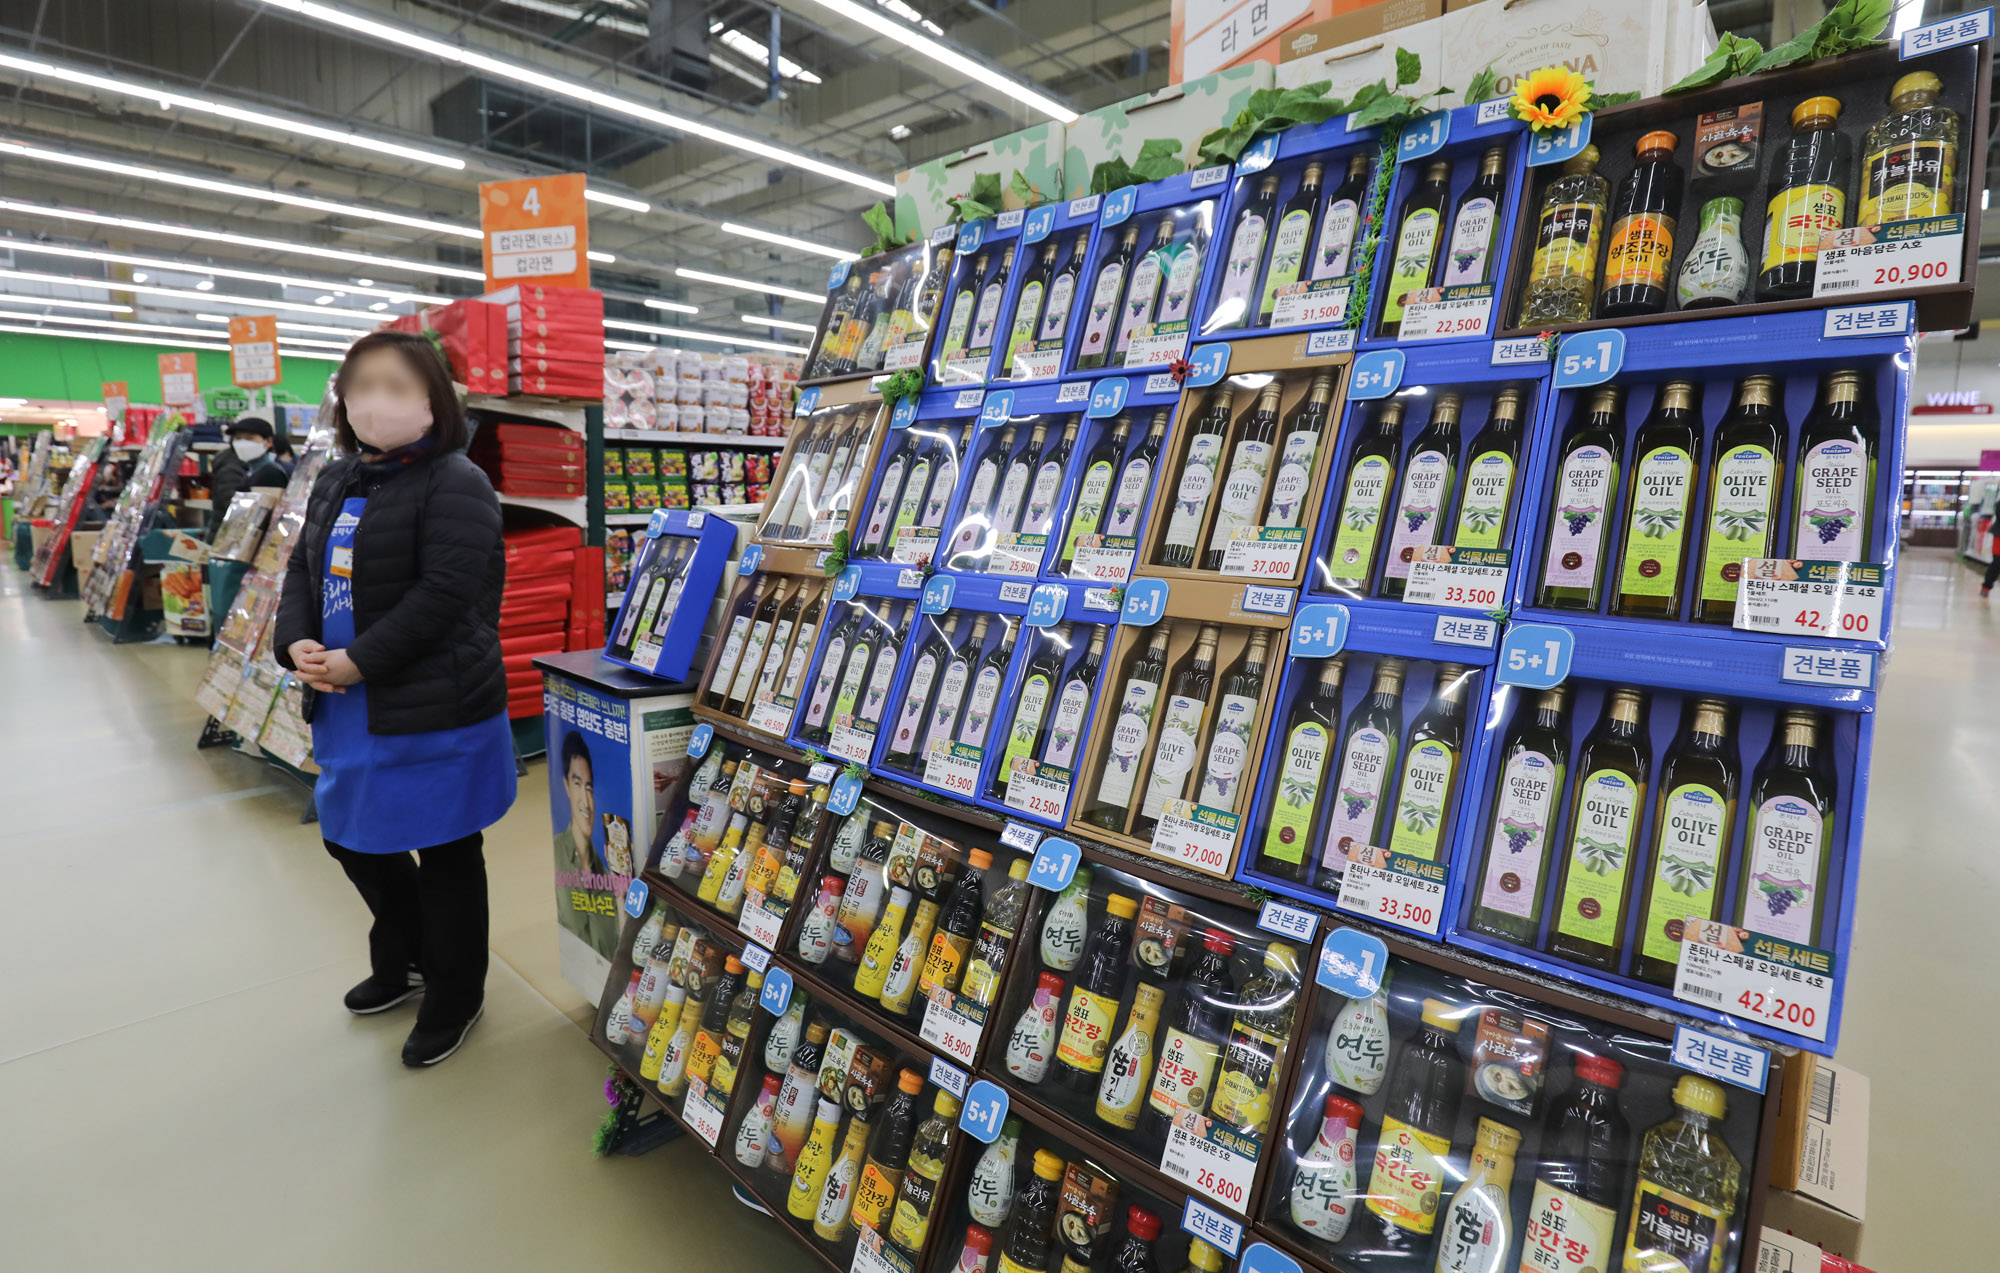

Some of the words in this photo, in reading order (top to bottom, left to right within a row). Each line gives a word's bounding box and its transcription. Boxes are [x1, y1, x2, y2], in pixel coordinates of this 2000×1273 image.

[1912, 18, 1980, 49] 견본품
[1552, 41, 1572, 50] TASTE
[1404, 119, 1442, 152] 5+1
[1700, 124, 1753, 144] 사골육수
[1874, 159, 1940, 182] 카놀라유
[522, 187, 541, 217] 4
[1105, 193, 1130, 218] 5+1
[1813, 202, 1837, 216] 샘표
[1027, 212, 1049, 235] 5+1
[1459, 216, 1488, 228] GRAPE
[1461, 225, 1484, 235] SEED
[500, 231, 568, 251] 컵라면(박스)
[960, 226, 981, 248] 5+1
[1280, 228, 1305, 239] OLIVE
[1405, 228, 1433, 240] OLIVE
[1629, 229, 1654, 239] 샘표
[1836, 228, 1857, 247] 설
[1886, 218, 1958, 240] 선물세트
[1408, 238, 1425, 247] OIL
[1611, 240, 1669, 260] 양조간장
[1825, 249, 1847, 261] 샘표
[1850, 242, 1897, 258] 마음담은
[1901, 239, 1923, 251] A호
[516, 255, 553, 273] 컵라면
[1627, 254, 1648, 265] 501
[1681, 246, 1733, 277] 연두
[1873, 261, 1948, 285] 20,900
[1301, 305, 1340, 322] 31,500
[1834, 308, 1899, 331] 견본품
[248, 321, 258, 338] 3
[1435, 317, 1482, 335] 22,500
[1314, 331, 1350, 350] 견본품
[1498, 342, 1544, 360] 견본품
[1563, 341, 1613, 376] 5+1
[1356, 360, 1396, 389] 5+1
[1094, 386, 1122, 409] 5+1
[1926, 390, 1981, 406] WINE
[1410, 472, 1441, 481] GRAPE
[1472, 477, 1506, 487] OLIVE
[1568, 469, 1605, 480] GRAPE
[1643, 476, 1684, 486] OLIVE
[1723, 475, 1768, 486] OLIVE
[1811, 467, 1858, 478] GRAPE
[1229, 483, 1259, 495] OLIVE
[1354, 479, 1382, 488] OLIVE
[1357, 488, 1375, 497] OIL
[1412, 481, 1436, 489] SEED
[1476, 487, 1497, 496] OIL
[1571, 479, 1599, 488] SEED
[1649, 486, 1674, 497] OIL
[1730, 486, 1757, 497] OIL
[1816, 478, 1852, 488] SEED
[1231, 491, 1249, 501] OIL
[1264, 528, 1302, 542] 선물세트
[1424, 546, 1438, 561] 설
[1459, 550, 1507, 566] 선물세트
[1094, 565, 1126, 578] 22,500
[1251, 559, 1290, 575] 37,000
[1414, 563, 1436, 572] 폰타나
[1437, 564, 1457, 574] 스페셜
[1460, 566, 1489, 576] 오일세트
[1490, 568, 1503, 577] 2호
[925, 585, 949, 608] 5+1
[1127, 590, 1160, 617] 5+1
[1251, 590, 1287, 611] 견본품
[1445, 586, 1496, 605] 33,500
[1298, 616, 1339, 647] 5+1
[1442, 621, 1489, 642] 견본품
[1508, 640, 1561, 677] 5+1
[1793, 653, 1863, 680] 견본품
[1023, 694, 1044, 706] OLIVE
[559, 700, 575, 725] 충분
[576, 707, 603, 735] 영양도
[603, 716, 628, 745] 충분!
[1116, 724, 1142, 738] GRAPE
[692, 732, 708, 753] 5+1
[1117, 731, 1136, 744] SEED
[844, 744, 867, 760] 31,500
[1160, 751, 1176, 764] OIL
[1213, 744, 1241, 759] GRAPE
[1213, 752, 1235, 765] SEED
[1291, 747, 1322, 762] OLIVE
[1350, 751, 1383, 765] GRAPE
[1295, 758, 1313, 771] OIL
[1352, 761, 1377, 773] SEED
[945, 773, 973, 792] 25,900
[1410, 767, 1445, 784] OLIVE
[1510, 776, 1548, 792] GRAPE
[1414, 778, 1436, 793] OIL
[1512, 787, 1541, 801] SEED
[833, 785, 857, 808] 5+1
[1029, 796, 1061, 817] 22,500
[1586, 800, 1630, 819] OLIVE
[1592, 813, 1618, 829] OIL
[1671, 816, 1718, 836] OLIVE
[1677, 830, 1706, 847] OIL
[1764, 825, 1814, 845] GRAPE
[1183, 842, 1223, 868] 37,000
[1768, 838, 1806, 856] SEED
[1036, 852, 1074, 883] 5+1
[1359, 845, 1374, 863] 설
[1393, 857, 1444, 881] 선물세트
[1349, 863, 1371, 877] 폰타나
[1371, 868, 1393, 883] 스페셜
[1395, 872, 1425, 890] 오일세트
[1427, 883, 1440, 894] 2호
[628, 890, 645, 912] 5+1
[1379, 896, 1432, 925] 33,500
[1140, 920, 1175, 940] 사골육수
[1268, 908, 1311, 934] 견본품
[753, 925, 774, 946] 36,900
[1046, 927, 1082, 953] 연두
[1702, 923, 1723, 944] 설
[1754, 938, 1830, 973] 선물세트
[744, 949, 766, 968] 견본품
[1688, 943, 1720, 962] 폰타나
[1722, 953, 1754, 972] 스페셜
[1757, 961, 1803, 983] 오일세트
[1806, 975, 1825, 989] 4호
[925, 965, 936, 977] 501
[765, 983, 787, 1009] 5+1
[955, 1001, 985, 1024] 선물세트
[1073, 1004, 1090, 1020] 샘표
[1738, 989, 1816, 1028] 42,200
[942, 1032, 972, 1058] 36,900
[1010, 1029, 1039, 1059] 연두
[1336, 1030, 1385, 1071] 연두
[1167, 1047, 1185, 1065] 샘표
[1686, 1036, 1753, 1078] 견본품
[934, 1063, 962, 1091] 견본품
[967, 1100, 1001, 1134] 5+1
[696, 1116, 718, 1142] 36,900
[1185, 1112, 1198, 1130] 설
[1213, 1127, 1257, 1159] 선물세트
[863, 1174, 877, 1188] 샘표
[1197, 1167, 1242, 1203] 26,800
[1295, 1170, 1342, 1212] 연두
[1063, 1191, 1097, 1217] 사골육수
[1669, 1208, 1691, 1226] 샘표
[1191, 1208, 1234, 1246] 견본품
[1640, 1210, 1710, 1252] 카놀라유
[1527, 1218, 1590, 1265] 진간장
